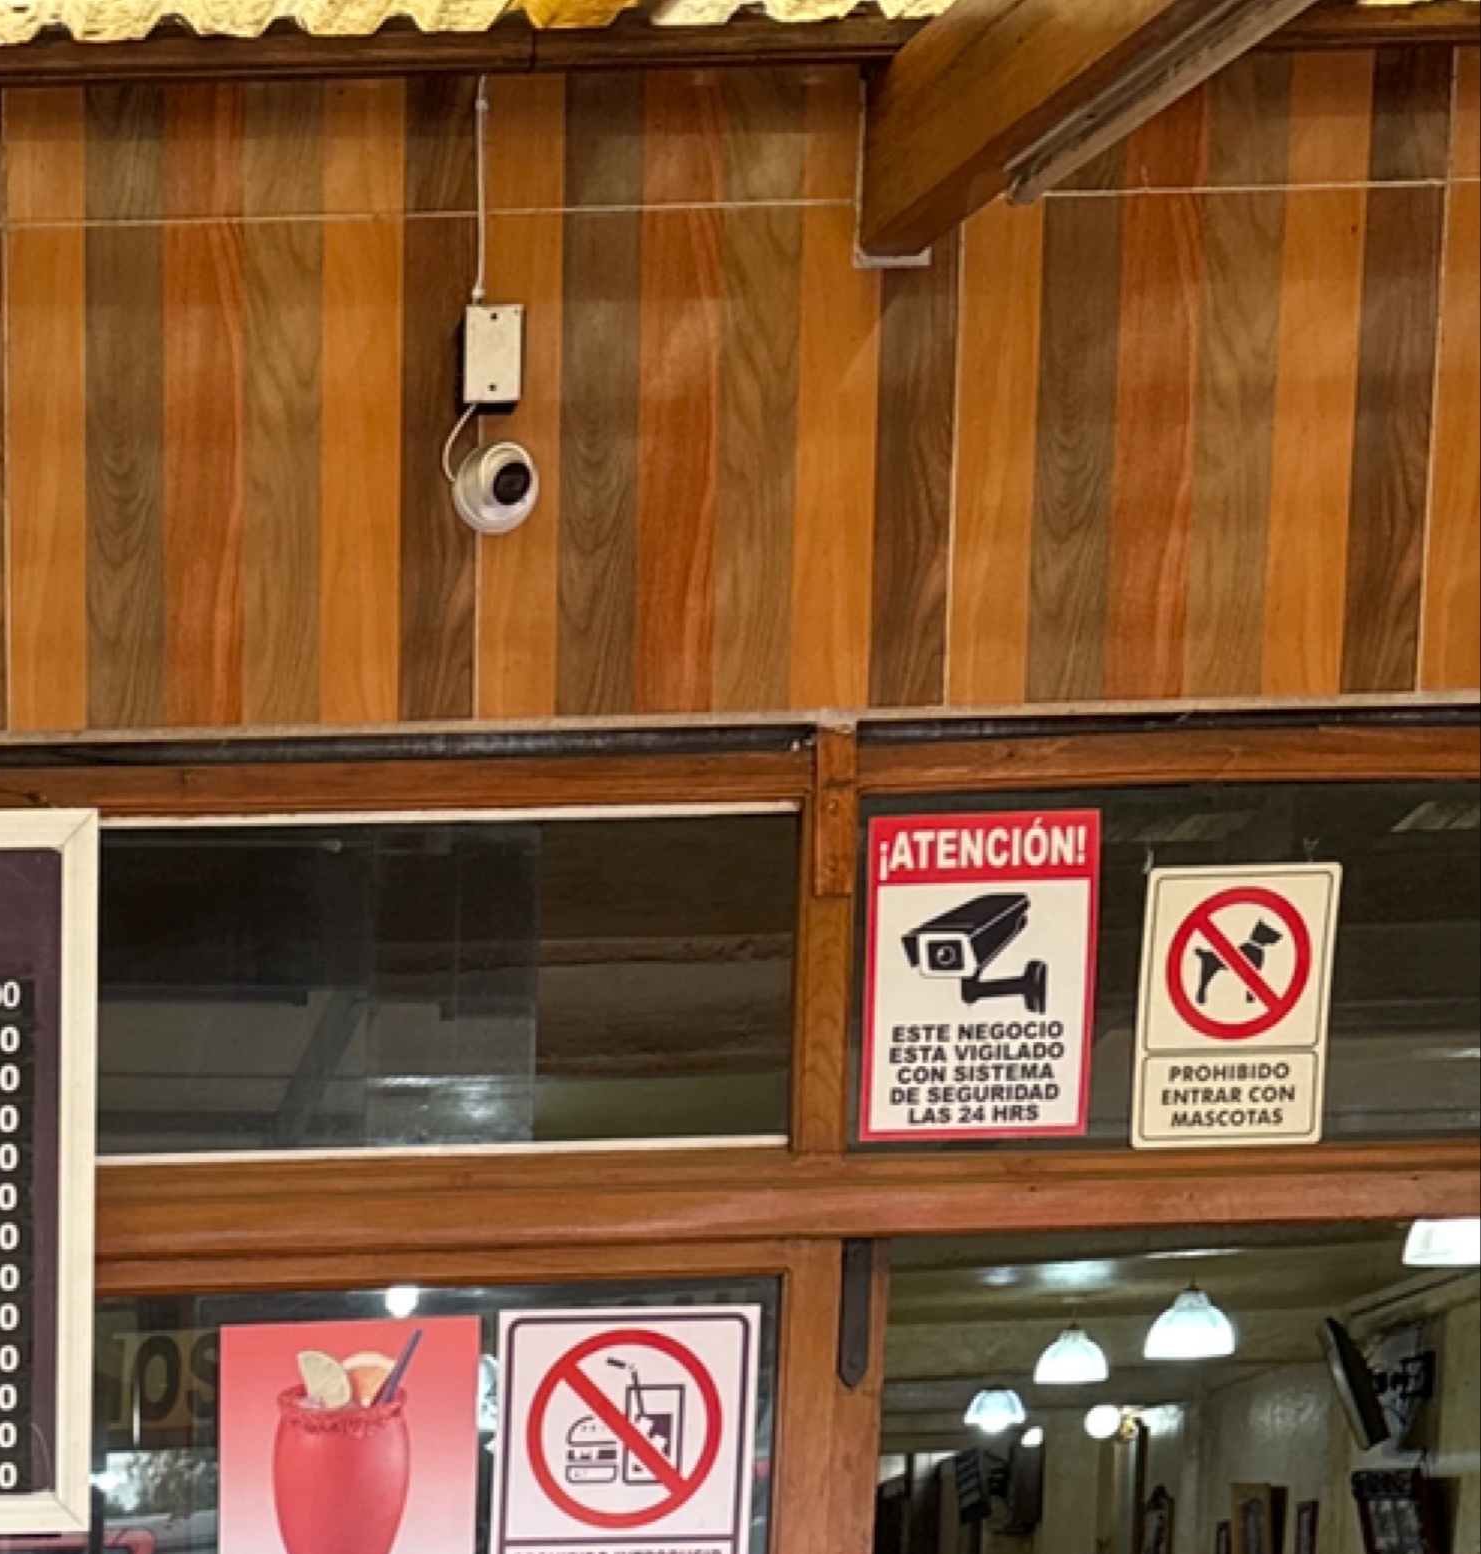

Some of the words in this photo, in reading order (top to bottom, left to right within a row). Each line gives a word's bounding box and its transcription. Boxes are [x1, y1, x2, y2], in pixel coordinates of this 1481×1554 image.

[878, 817, 1087, 881] ¡ATENCIÓN!
[892, 1023, 950, 1043] ESTE
[957, 1020, 1064, 1041] NEGOCIO
[889, 1044, 947, 1064] ESTA
[954, 1041, 1065, 1061] VIGILADO
[897, 1065, 947, 1085] CON
[954, 1062, 1055, 1082] SISTEMA
[1168, 1062, 1290, 1082] PROHIBIDO
[889, 1086, 919, 1106] DE
[927, 1083, 1060, 1104] SEGURIDAD
[1161, 1086, 1242, 1106] ENTRAR
[1248, 1086, 1296, 1103] CON
[907, 1107, 951, 1125] LAS
[958, 1105, 986, 1124] 24
[992, 1104, 1039, 1122] HRS
[1170, 1107, 1284, 1127] MASCOTAS
